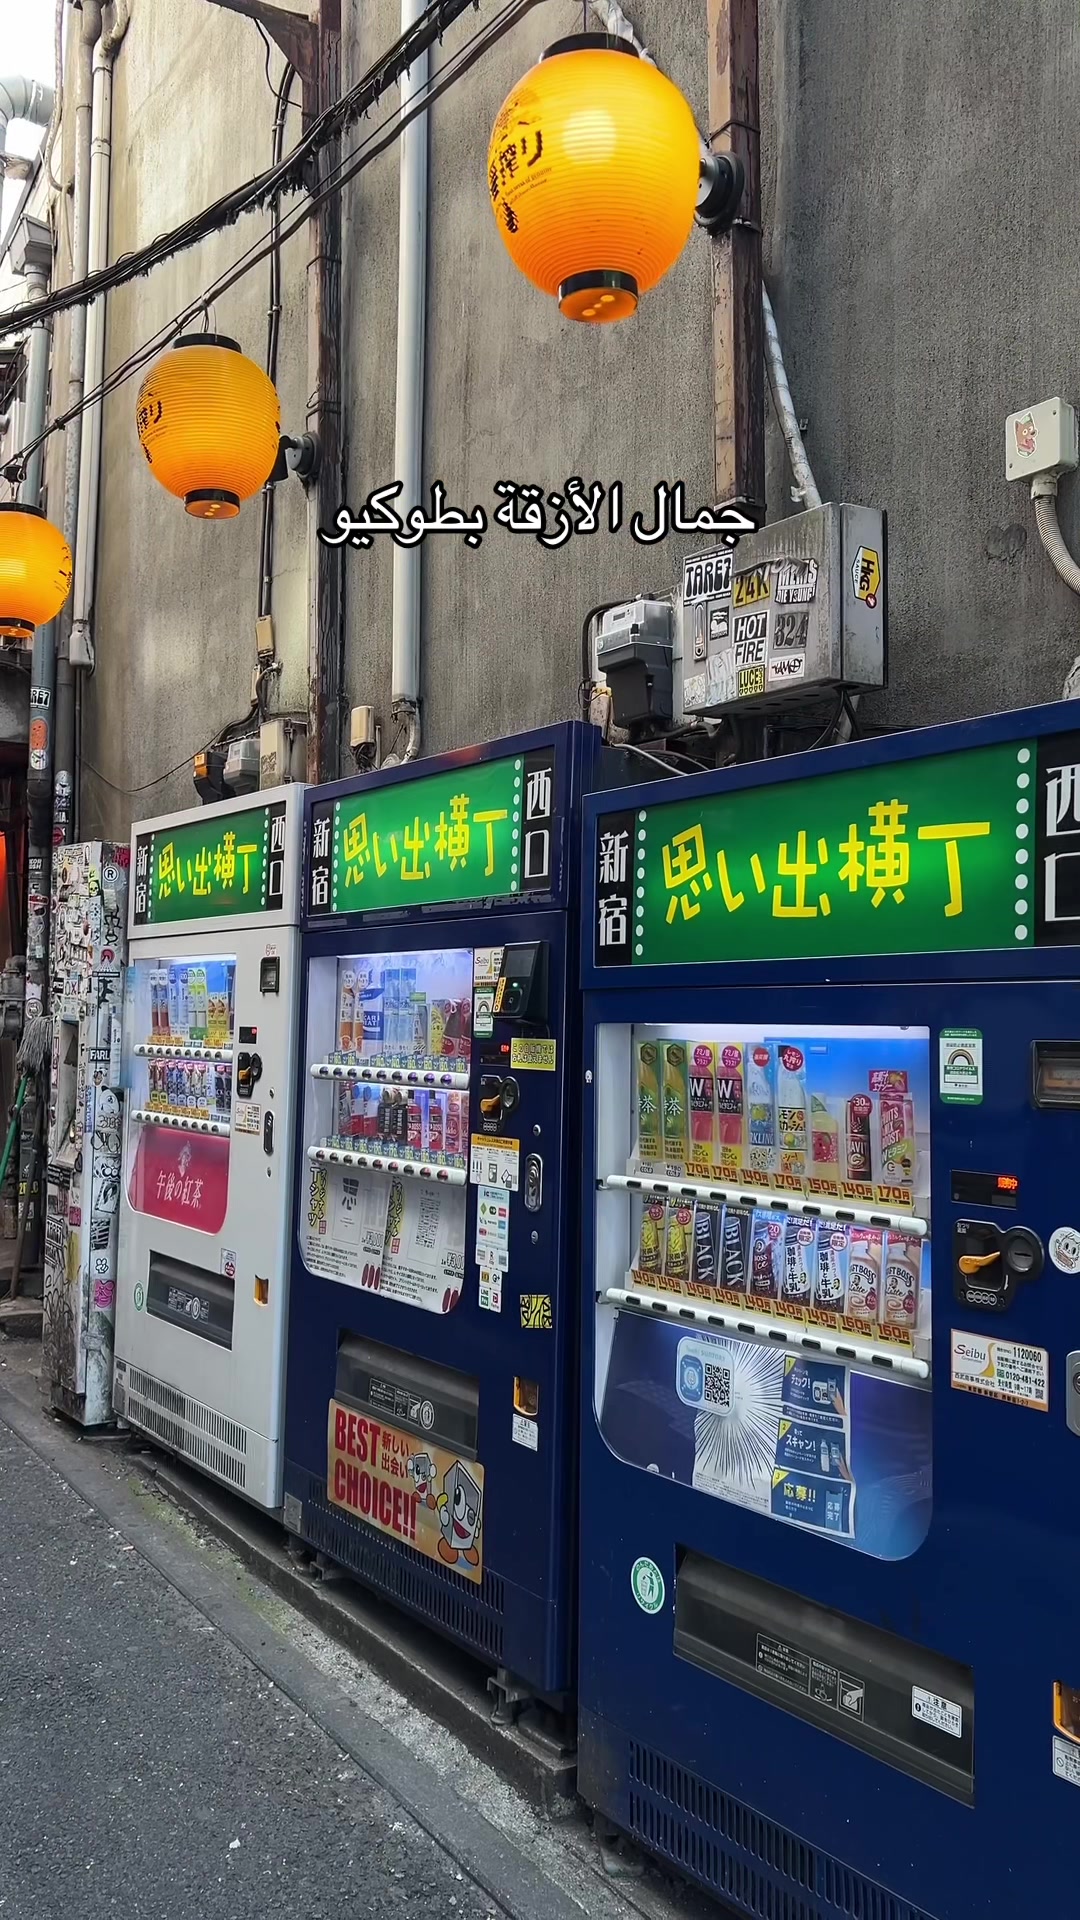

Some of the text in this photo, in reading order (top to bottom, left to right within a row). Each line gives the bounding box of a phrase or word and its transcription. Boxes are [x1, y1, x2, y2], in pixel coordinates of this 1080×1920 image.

[861, 557, 875, 592] HKG
[736, 613, 766, 642] HOT
[735, 639, 765, 666] FIRE
[739, 668, 759, 688] LUCE
[523, 767, 553, 878] 西口
[343, 793, 509, 887] 思い出横丁
[1043, 763, 1080, 923] 西口
[158, 831, 258, 900] 思い出横丁
[268, 815, 286, 897] 西口
[312, 817, 331, 906] 新宿
[661, 798, 991, 926] 思い出横丁
[135, 845, 148, 914] 新宿
[598, 829, 629, 946] 新宿
[690, 1078, 705, 1097] W
[717, 1080, 732, 1099] W
[685, 1162, 710, 1176] 170円
[712, 1165, 738, 1179] 170円
[741, 1168, 769, 1183] 140円
[156, 1170, 204, 1209] 午後の紅茶
[773, 1173, 801, 1187] 170円
[807, 1177, 837, 1192] 150円
[841, 1181, 873, 1196] 140円
[877, 1185, 910, 1200] 170円
[696, 1219, 715, 1281] BLACK
[725, 1224, 744, 1287] BLACK
[632, 1269, 656, 1284] 140円
[657, 1273, 680, 1289] 140円
[859, 1266, 877, 1285] BOSS
[896, 1269, 915, 1287] BOSS
[685, 1281, 711, 1296] 140円
[713, 1287, 739, 1303] 140円
[743, 1293, 771, 1309] 140円
[774, 1300, 803, 1316] 140円
[805, 1307, 837, 1324] 140円
[842, 1315, 872, 1331] 160円
[878, 1323, 910, 1340] 160円
[954, 1344, 986, 1361] Seibu
[791, 1374, 811, 1389] チェック!
[335, 1408, 380, 1468] BEST
[382, 1431, 410, 1457] 新しい
[786, 1434, 816, 1452] スキャン!
[381, 1452, 409, 1479] 出会い
[334, 1458, 417, 1541] CHOICE!!
